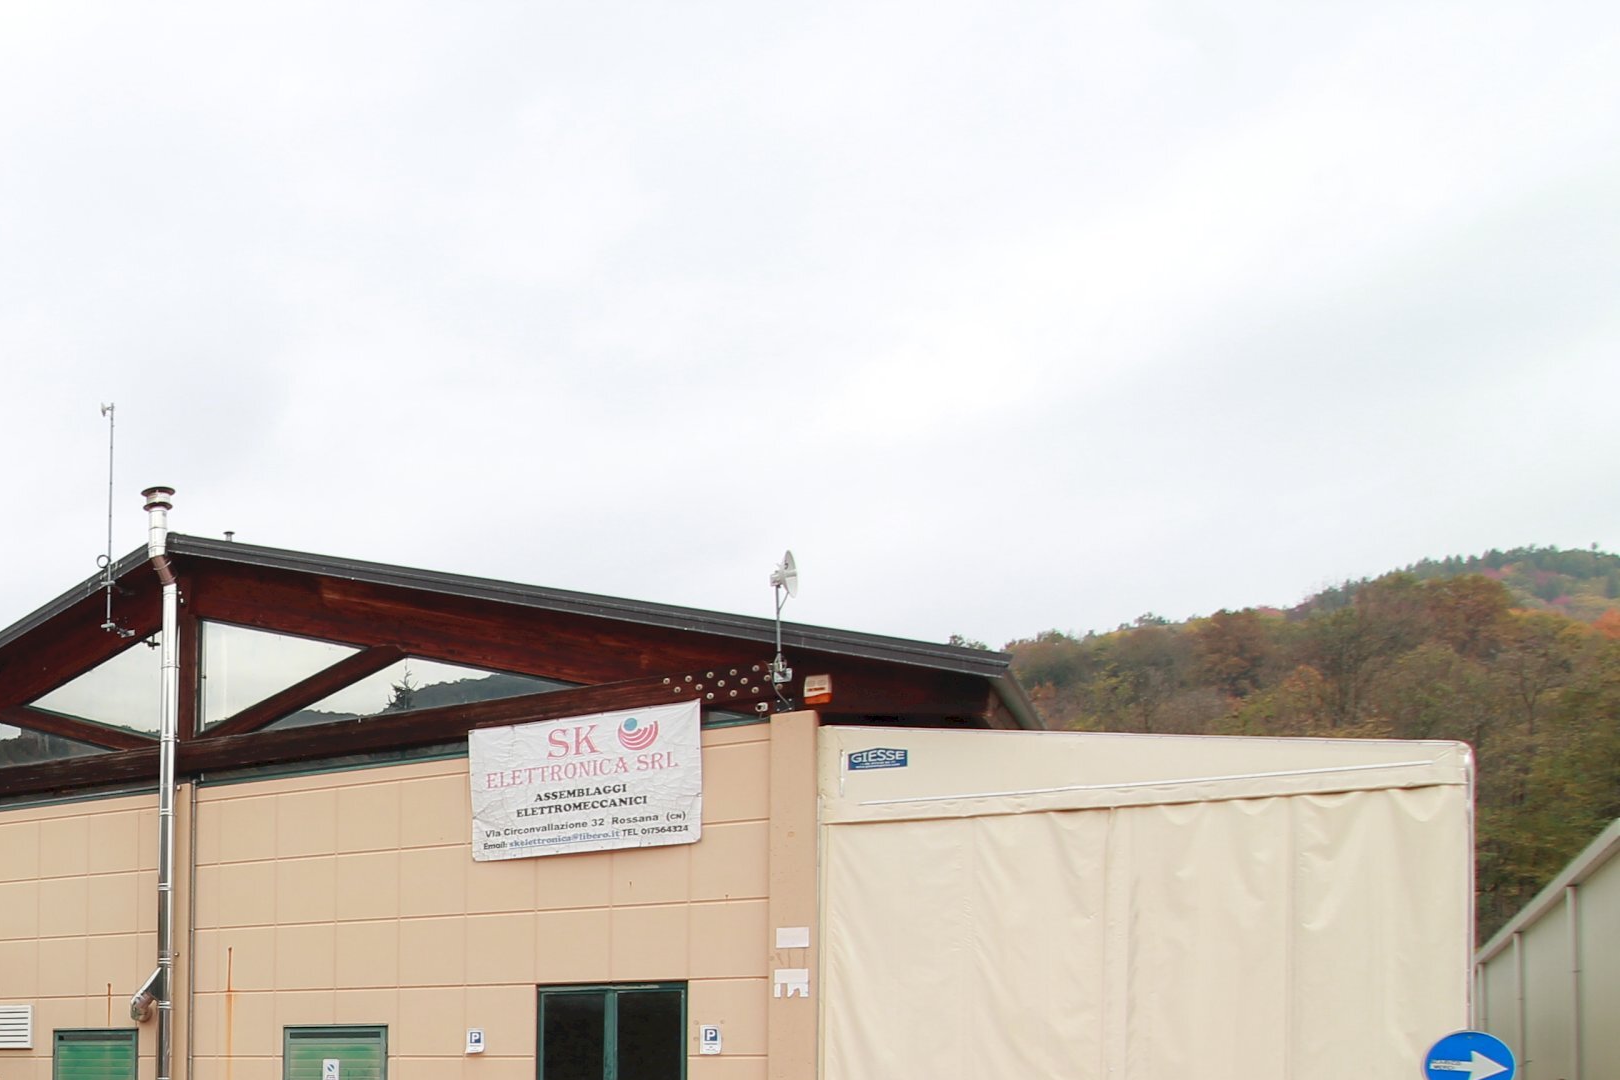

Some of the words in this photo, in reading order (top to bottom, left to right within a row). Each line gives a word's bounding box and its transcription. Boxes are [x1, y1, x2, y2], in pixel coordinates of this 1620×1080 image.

[547, 724, 603, 760] SK
[851, 749, 905, 763] GIESSE
[486, 757, 629, 789] ELETTRONICA
[636, 751, 679, 771] SRL
[534, 784, 627, 802] ASSEMBLAGGI
[516, 796, 648, 818] ELETTROMECCANICI
[503, 820, 588, 837] Circonvallazione
[591, 818, 605, 827] 32
[611, 813, 659, 825] Rossana
[666, 811, 686, 822] (CN)
[483, 841, 509, 850] Email:
[622, 829, 638, 838] TEL
[471, 1032, 480, 1043] P
[705, 1029, 716, 1041] P
